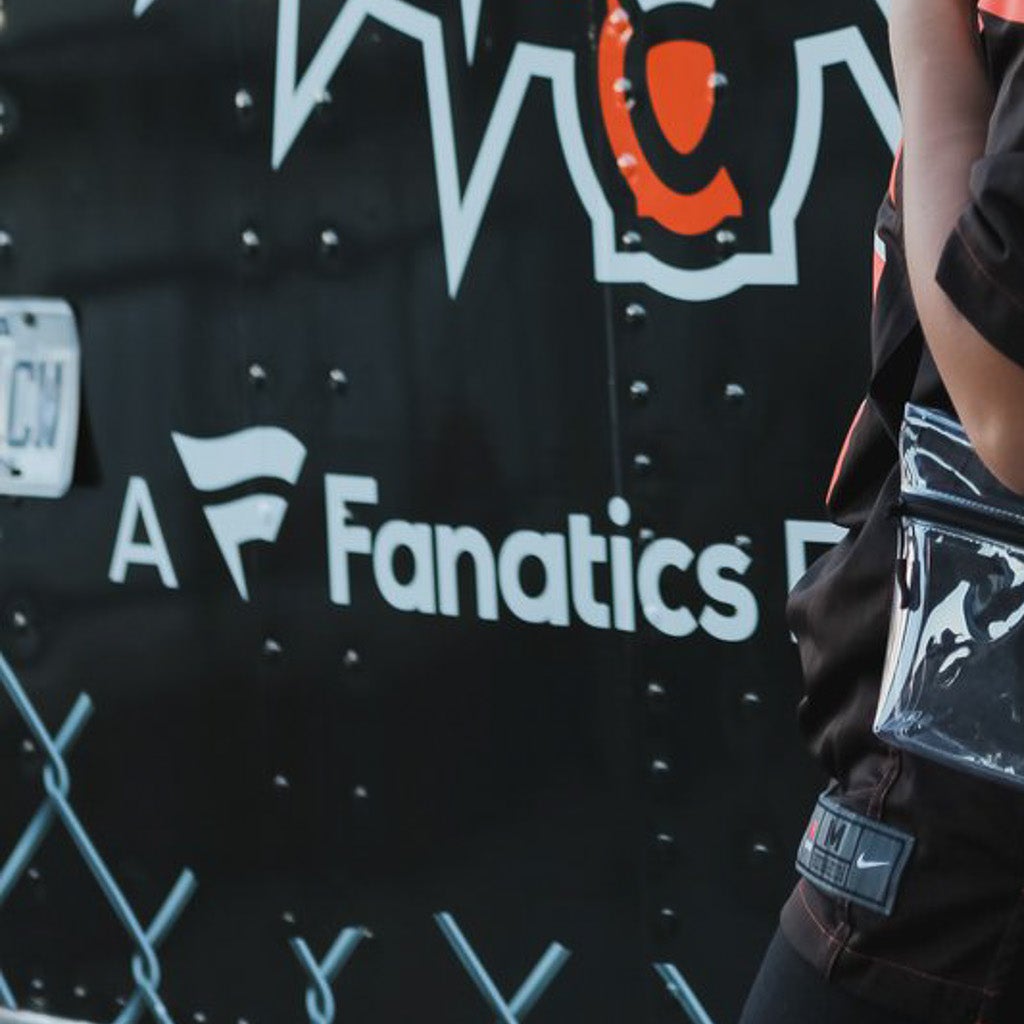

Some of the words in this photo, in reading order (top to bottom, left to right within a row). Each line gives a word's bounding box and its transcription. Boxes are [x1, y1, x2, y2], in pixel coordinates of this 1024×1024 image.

[108, 475, 181, 589] A
[324, 472, 760, 643] Fanatics
[822, 816, 847, 852] M
